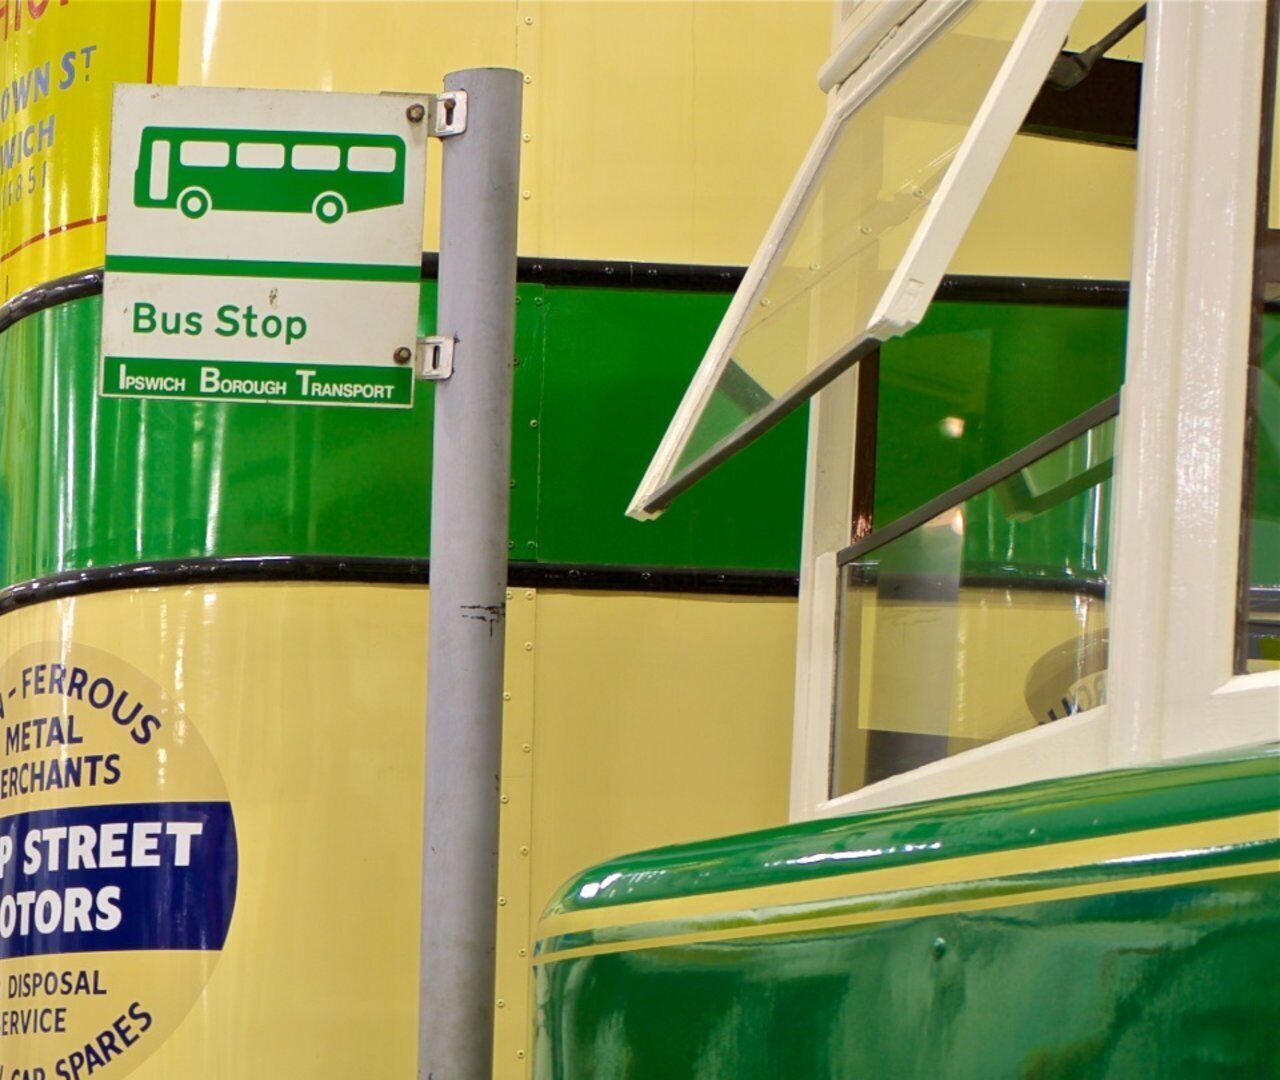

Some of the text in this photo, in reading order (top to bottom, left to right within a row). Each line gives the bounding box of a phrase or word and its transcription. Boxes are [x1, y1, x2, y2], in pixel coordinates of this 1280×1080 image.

[133, 302, 308, 345] Bus Stop
[5, 716, 84, 756] METAL
[23, 821, 203, 876] STREET
[8, 969, 108, 1000] DISPOSAL
